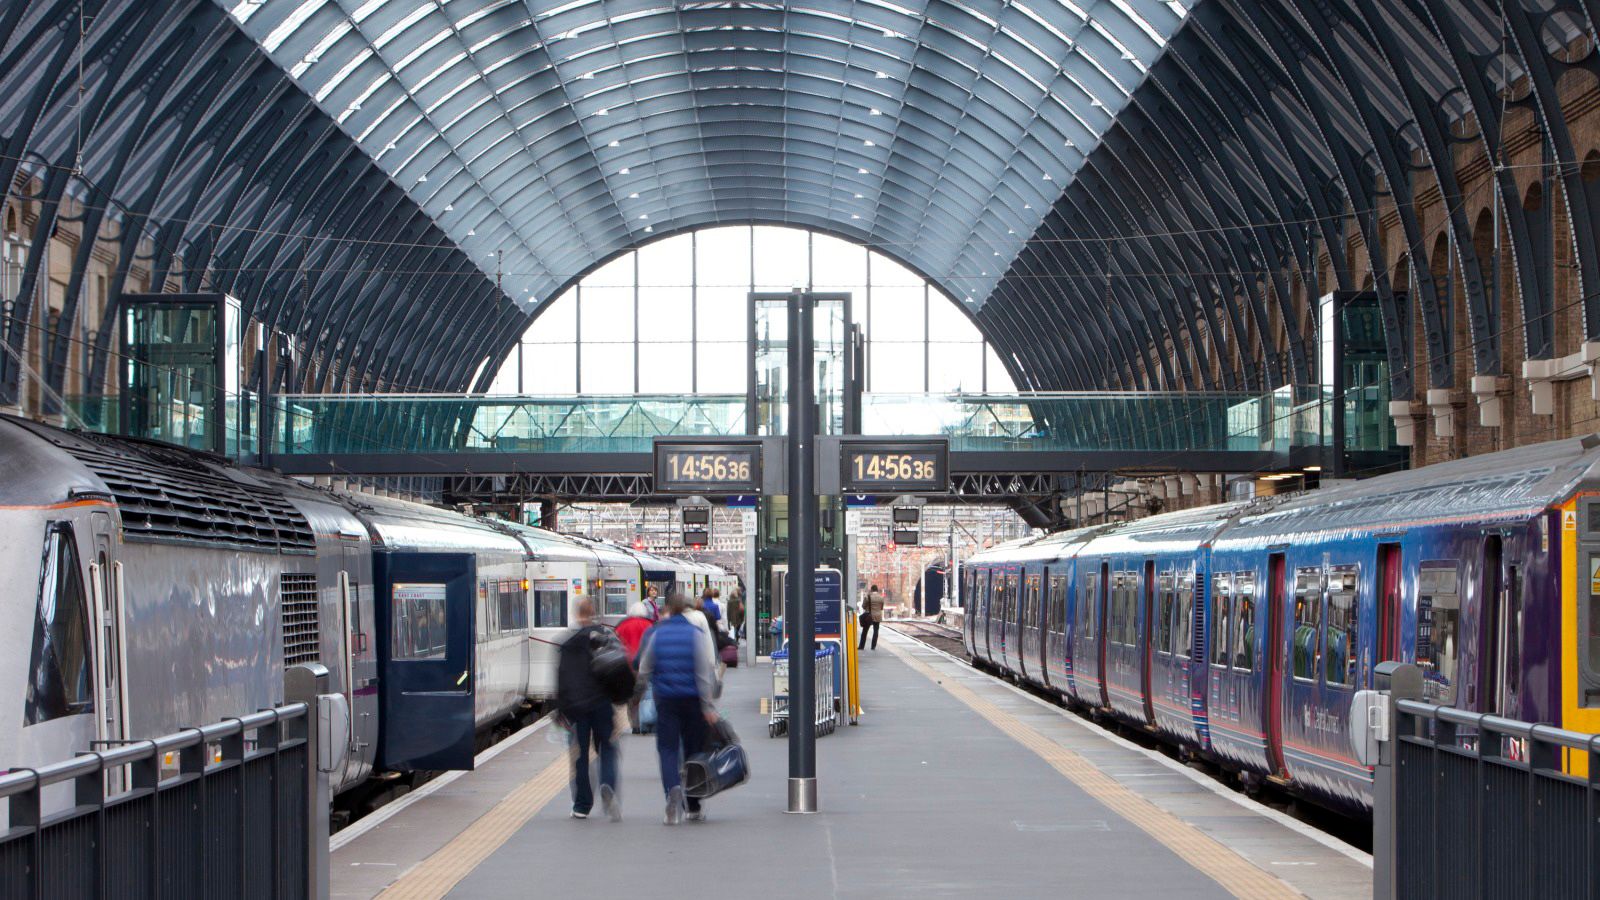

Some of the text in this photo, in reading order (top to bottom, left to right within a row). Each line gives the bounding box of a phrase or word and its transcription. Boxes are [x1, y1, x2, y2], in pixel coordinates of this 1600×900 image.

[669, 455, 750, 480] 14:56 36
[854, 454, 935, 480] 14:56 36
